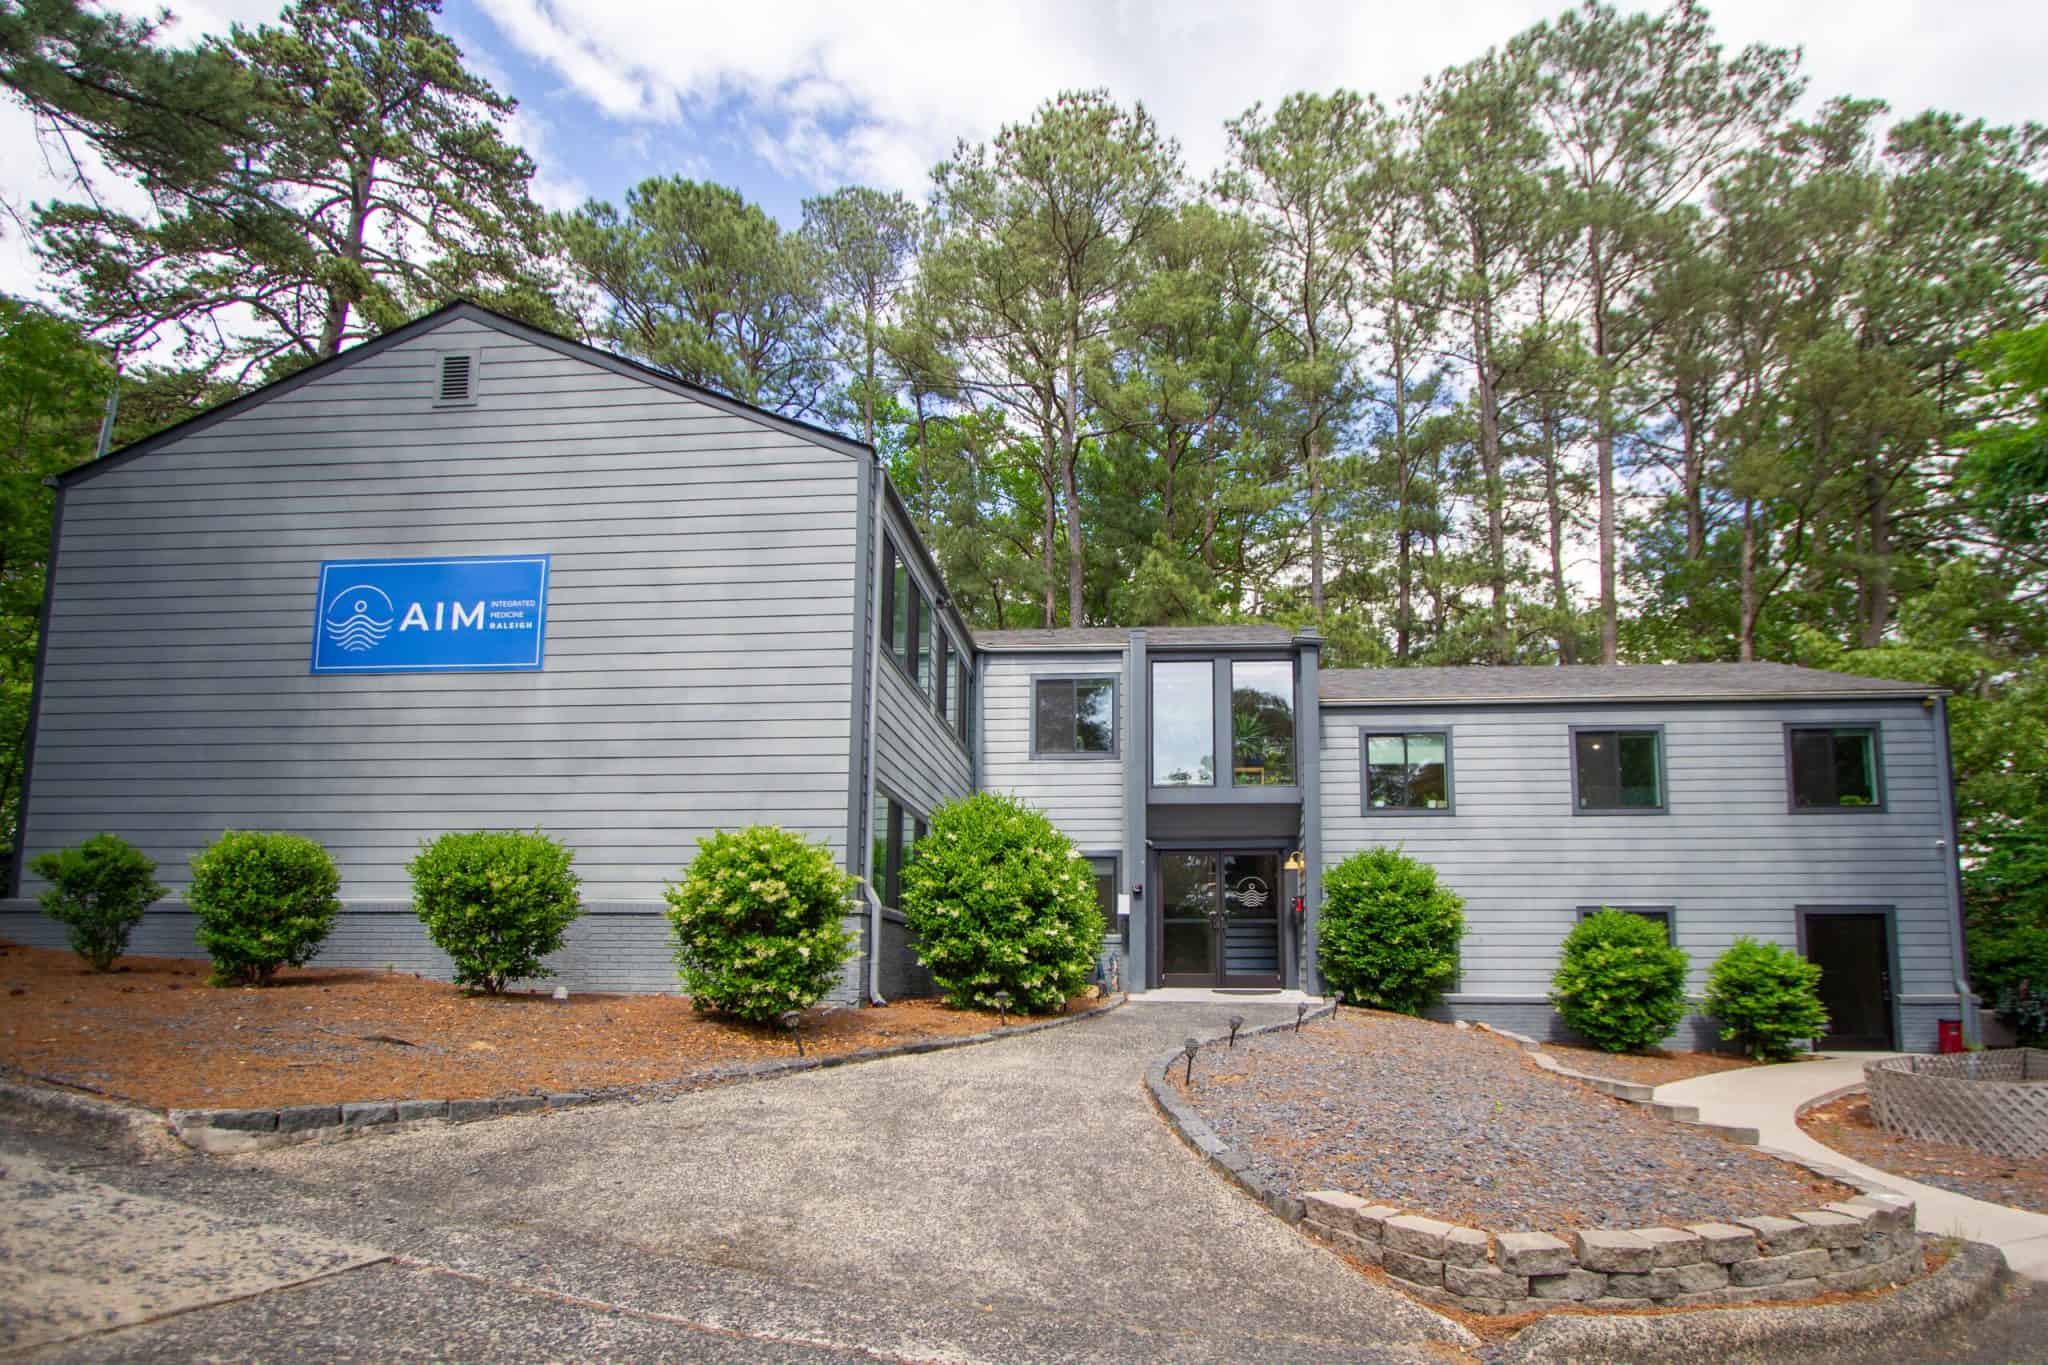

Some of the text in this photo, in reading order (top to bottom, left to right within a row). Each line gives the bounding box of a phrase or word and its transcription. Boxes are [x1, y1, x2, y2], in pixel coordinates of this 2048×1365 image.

[491, 599, 536, 608] INTEGRATED
[399, 601, 486, 632] AIM
[490, 611, 524, 619] MEDICINE
[489, 621, 533, 630] RALEIGH
